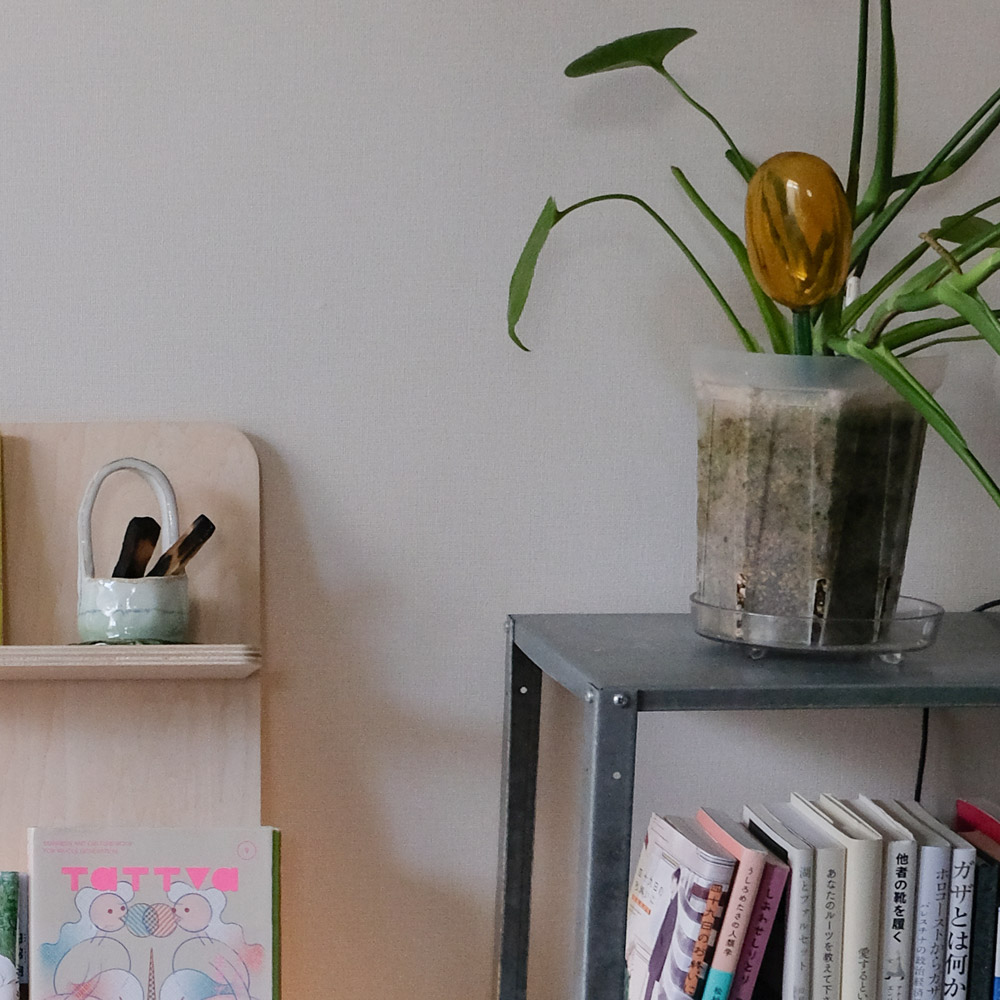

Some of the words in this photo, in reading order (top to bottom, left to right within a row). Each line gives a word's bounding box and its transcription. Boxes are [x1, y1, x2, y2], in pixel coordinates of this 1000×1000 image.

[724, 867, 754, 957] うしろめたさの人類学
[891, 853, 909, 943] 他者の靴を履く
[943, 861, 973, 997] ガザとは何か
